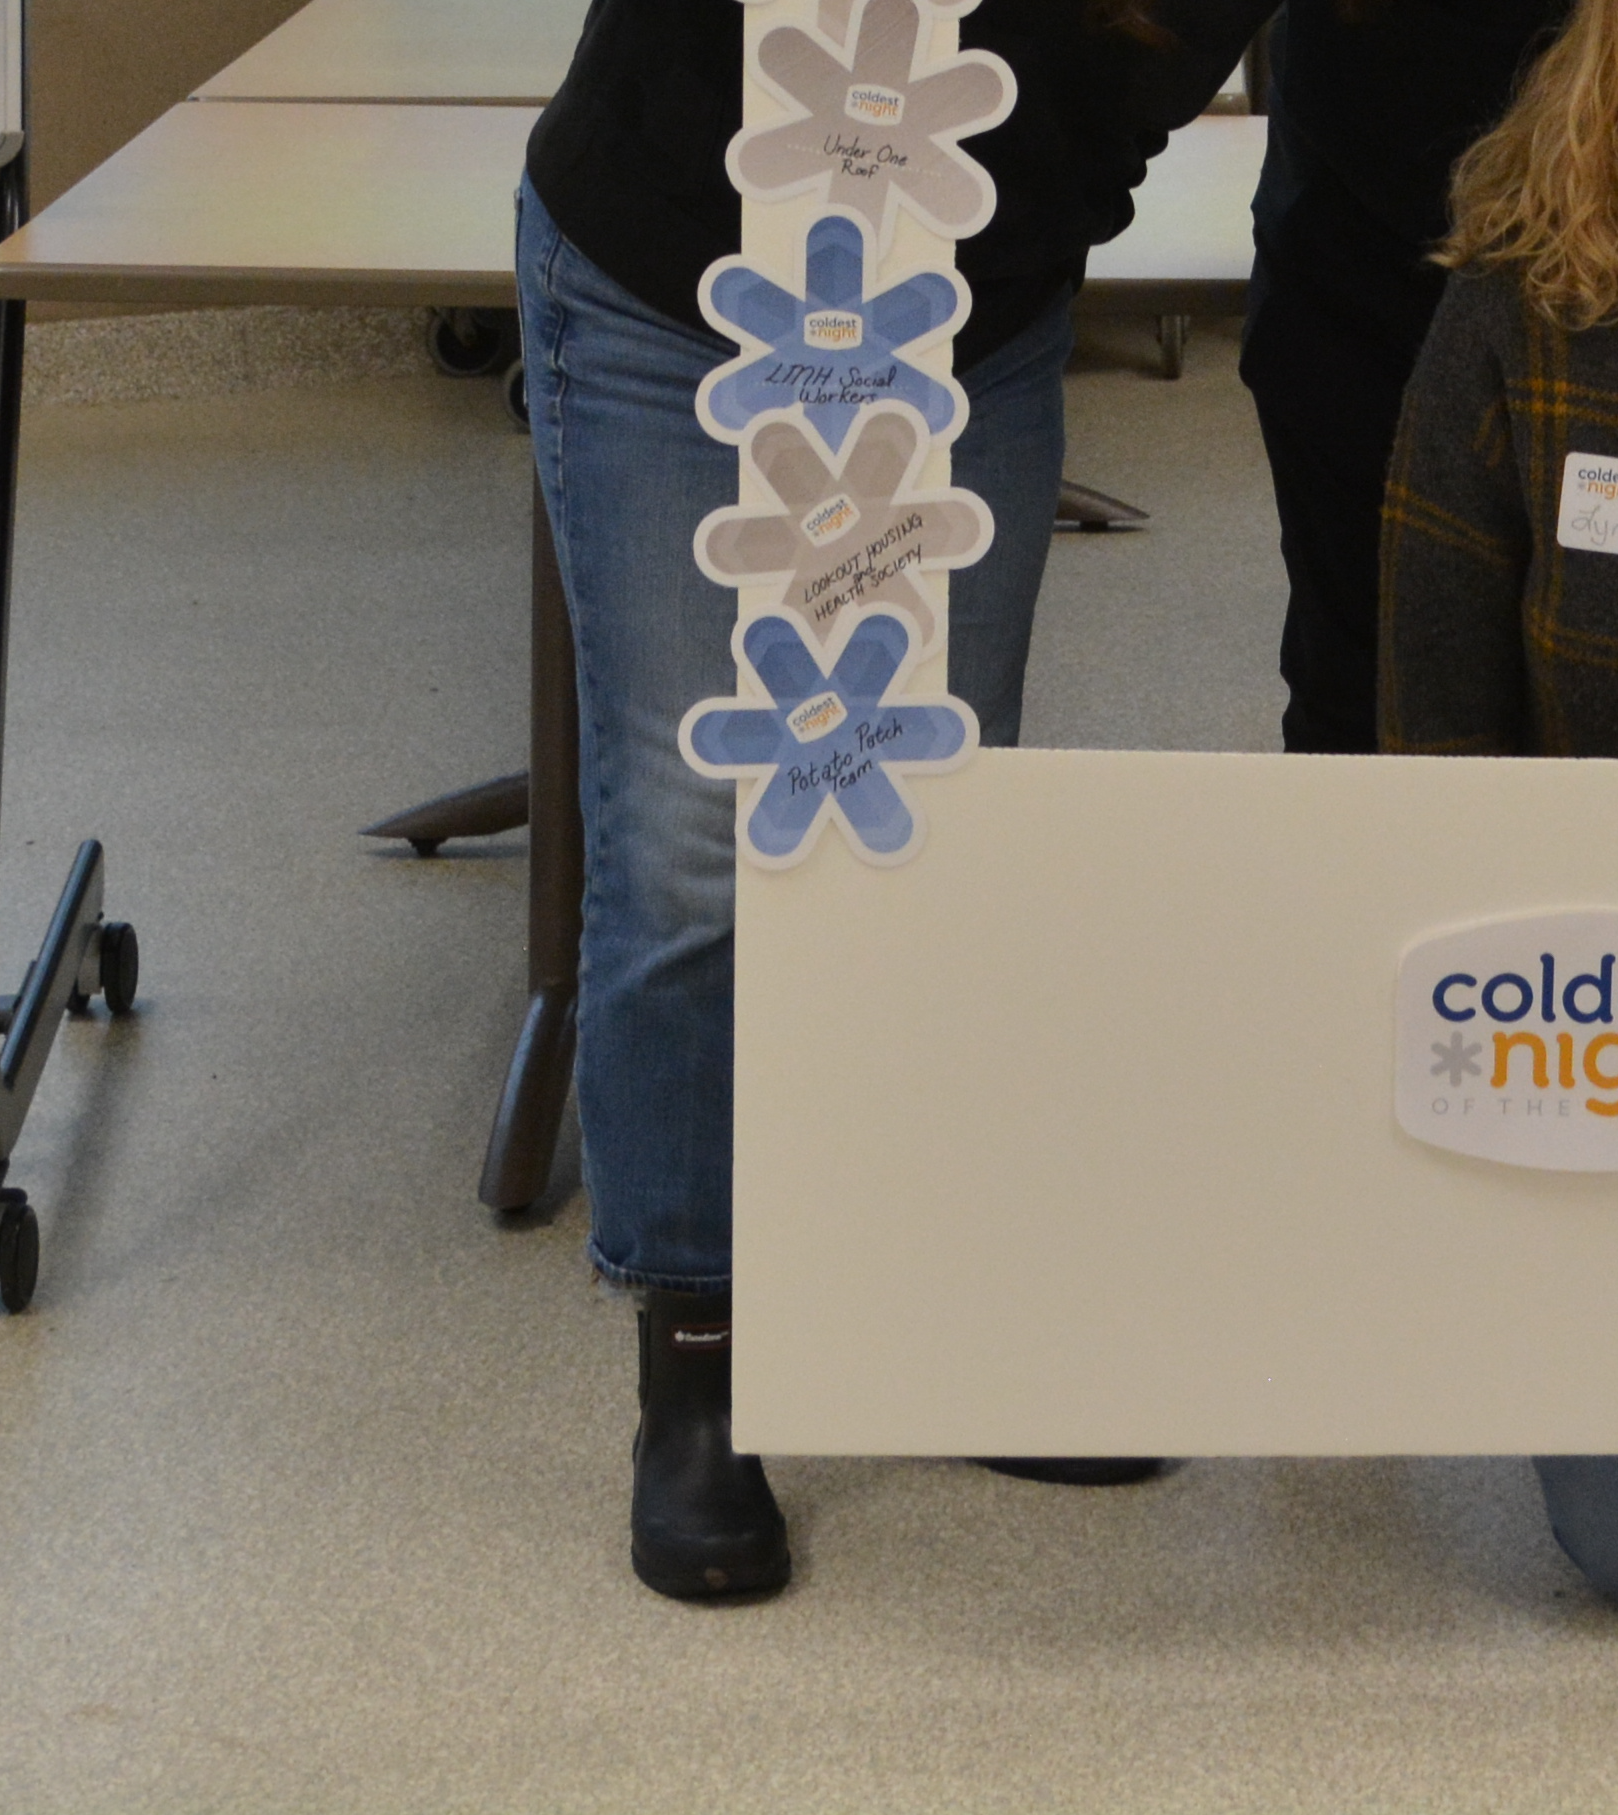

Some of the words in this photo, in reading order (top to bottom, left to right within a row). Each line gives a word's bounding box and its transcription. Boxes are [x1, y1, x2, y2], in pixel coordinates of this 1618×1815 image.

[852, 90, 899, 107] coldest
[859, 100, 898, 118] night
[824, 133, 871, 159] Under
[877, 145, 908, 167] One
[842, 159, 879, 179] Roof
[809, 316, 857, 328] coldest
[818, 326, 857, 342] night
[765, 363, 834, 386] LMH
[839, 365, 898, 389] Social
[799, 388, 878, 405] Workers
[806, 499, 848, 531] coldest
[819, 506, 853, 534] night
[803, 553, 861, 603] LOOKOUT
[867, 512, 923, 566] HOUSING
[815, 583, 864, 622] HEALTH
[793, 697, 835, 727] coldest
[805, 705, 840, 731] night
[788, 751, 853, 796] Potato
[855, 717, 903, 752] Patch
[829, 760, 873, 791] Team
[1432, 1097, 1476, 1116] OF
[1500, 1097, 1571, 1117] THE
